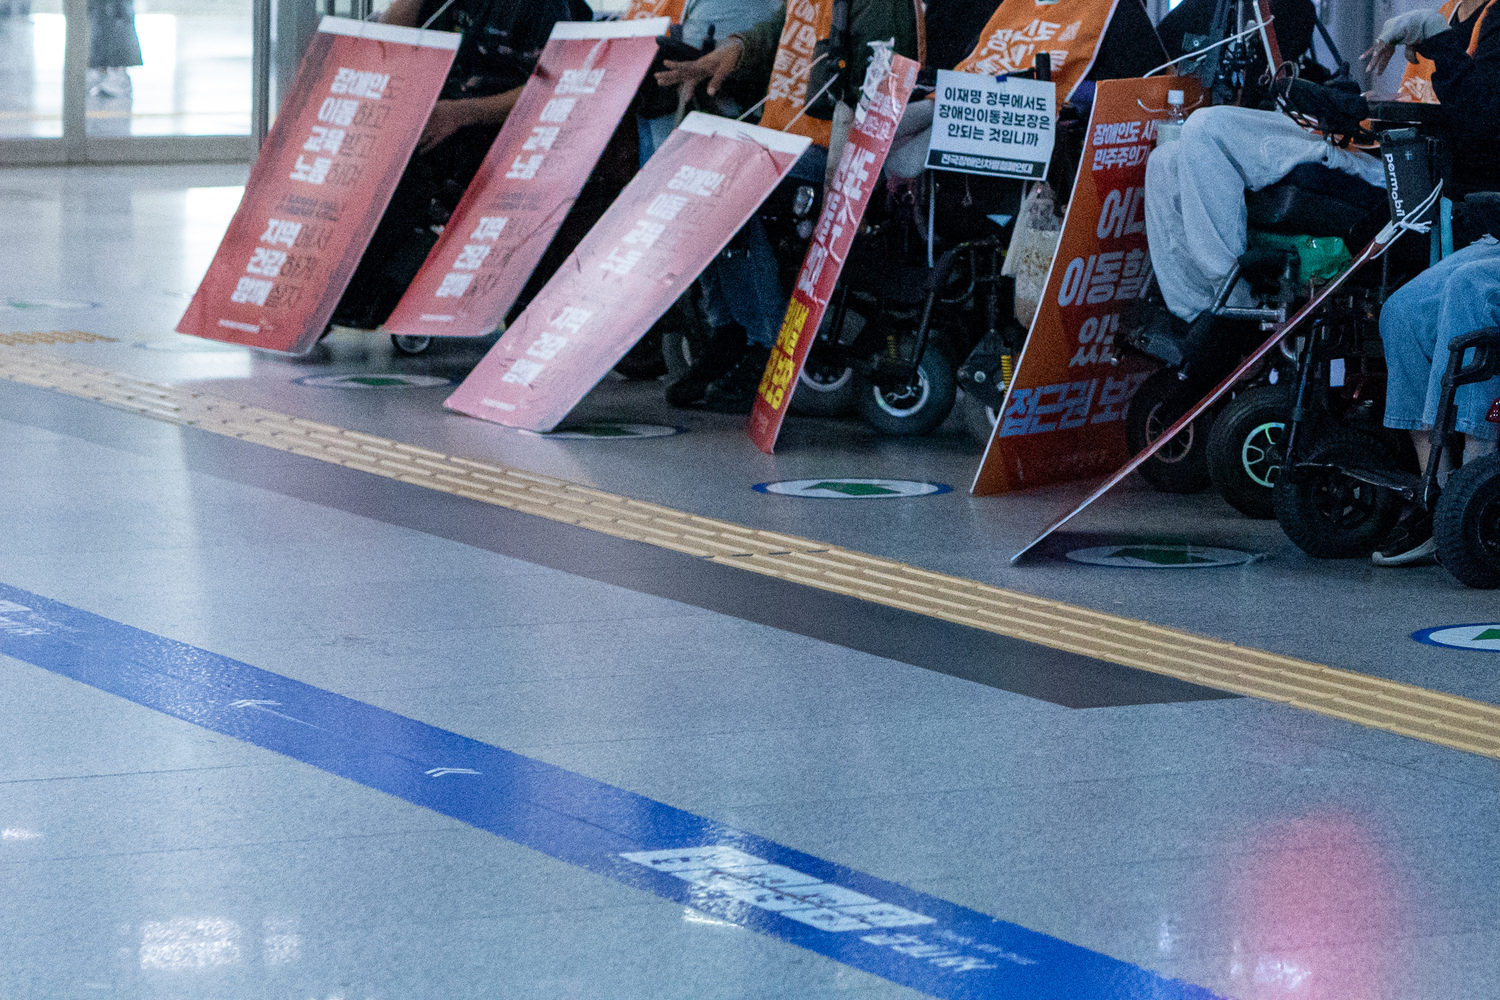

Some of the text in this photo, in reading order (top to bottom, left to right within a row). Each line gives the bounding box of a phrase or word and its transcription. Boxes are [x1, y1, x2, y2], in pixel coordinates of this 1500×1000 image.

[945, 87, 1047, 112] 이재명 정부에서도
[939, 104, 1050, 131] 장애인이동권보장은
[948, 123, 1039, 147] 안되는 것입니까
[1092, 121, 1141, 146] 장애인도
[1384, 153, 1406, 217] permobil
[999, 378, 1097, 438] 접근권
